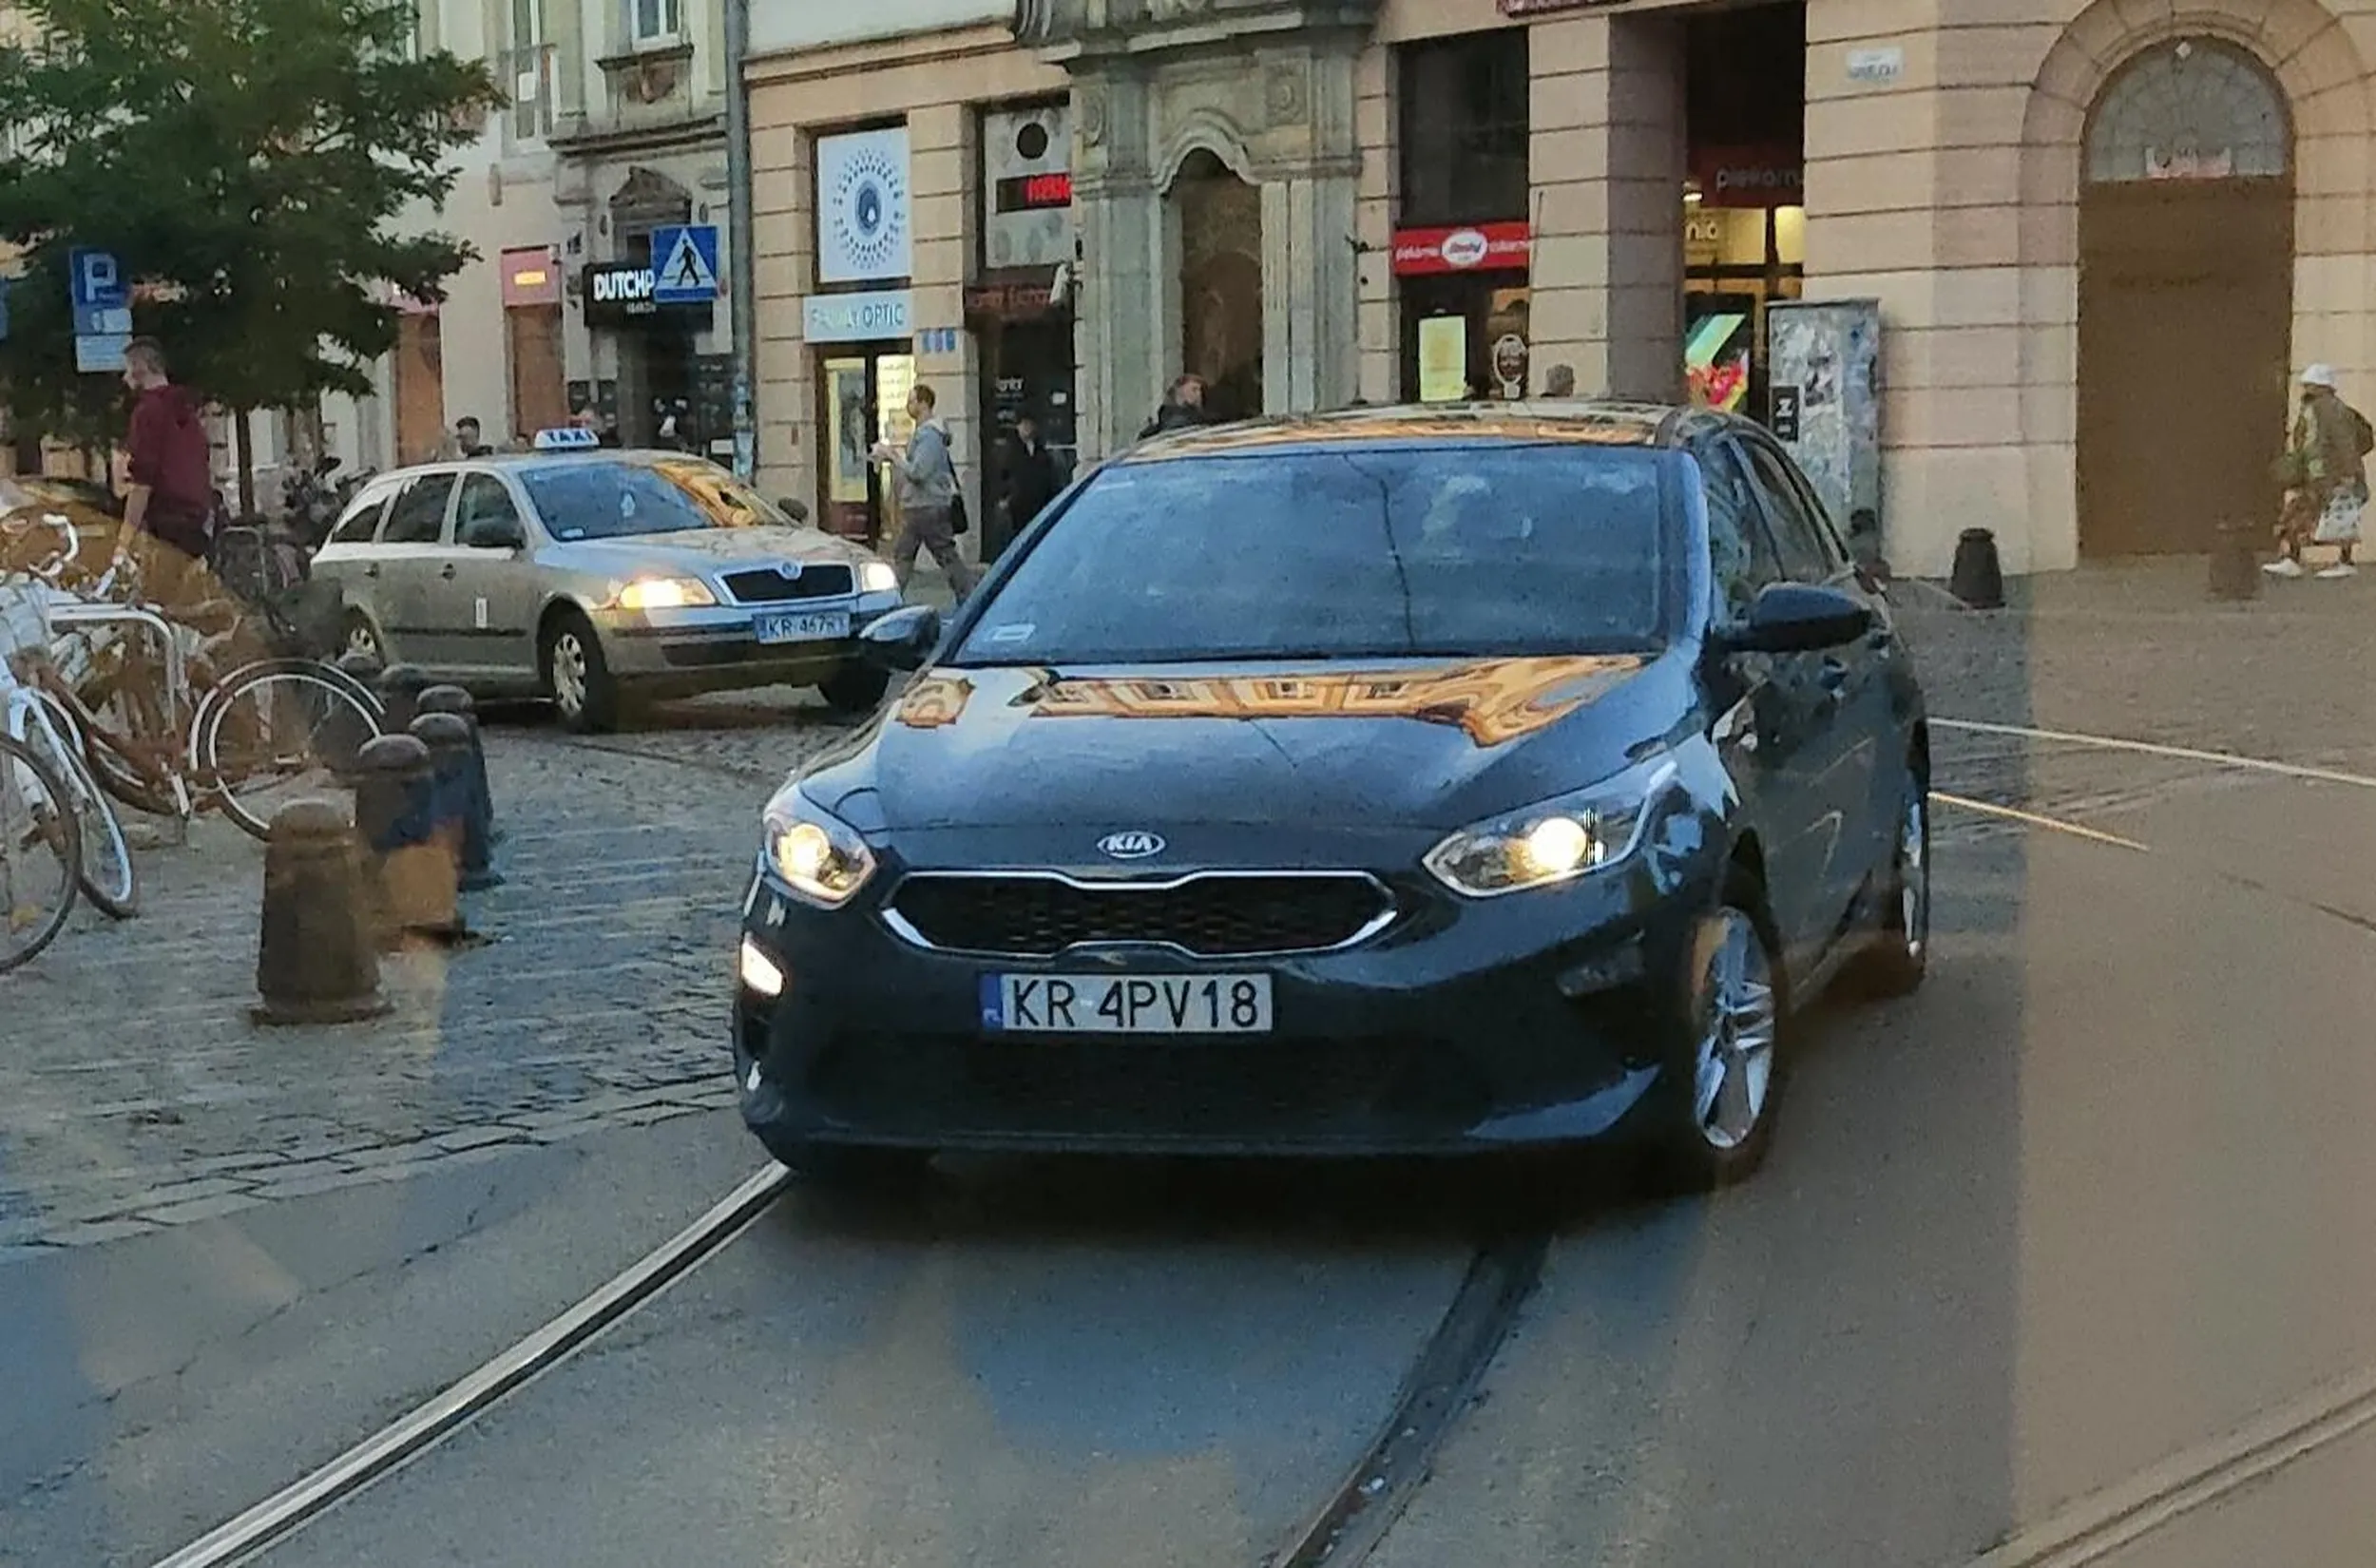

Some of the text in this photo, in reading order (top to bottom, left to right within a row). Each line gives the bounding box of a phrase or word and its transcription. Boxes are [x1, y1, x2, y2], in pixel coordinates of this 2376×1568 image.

[83, 253, 117, 302] P
[862, 302, 905, 329] OPTIC
[545, 430, 593, 443] TAXI
[767, 617, 793, 639] KR
[1106, 836, 1153, 851] KIA
[1013, 979, 1257, 1028] KR 4PV18
